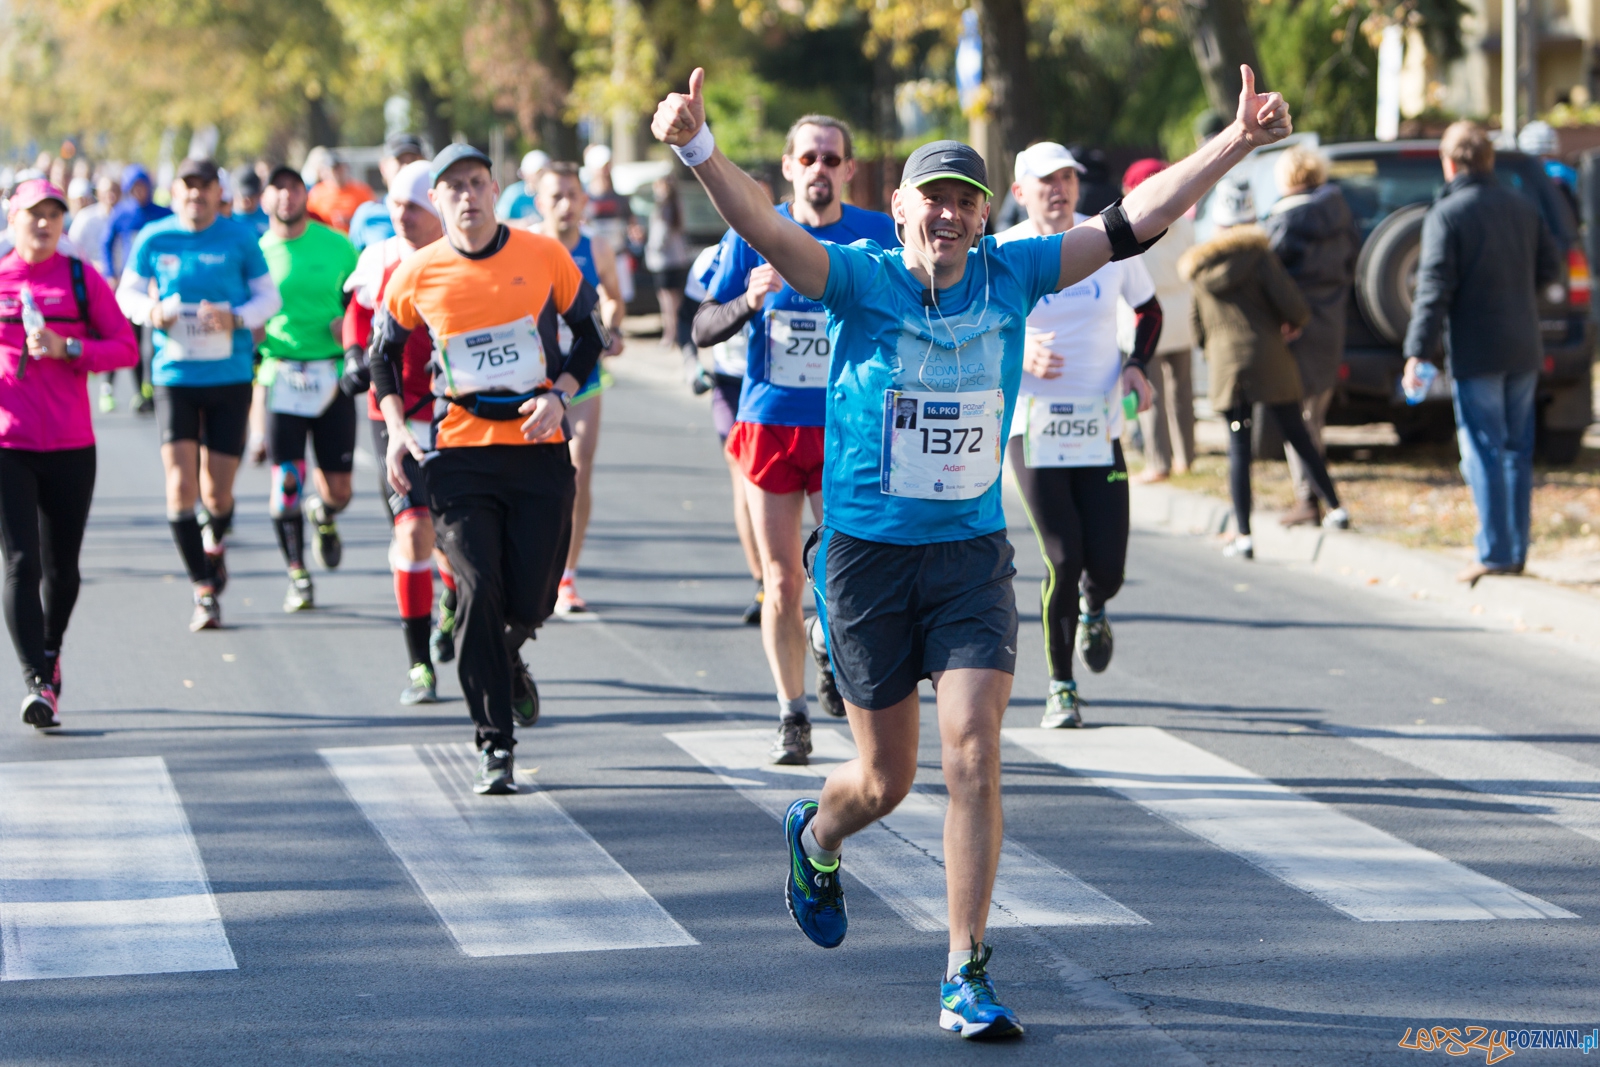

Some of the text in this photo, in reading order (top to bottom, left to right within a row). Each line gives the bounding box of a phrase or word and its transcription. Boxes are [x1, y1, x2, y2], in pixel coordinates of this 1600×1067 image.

[785, 336, 830, 356] 270
[471, 343, 519, 371] 765
[925, 362, 985, 377] ODWAGA
[927, 407, 958, 415] 16. PKO
[1042, 419, 1098, 437] 4056
[919, 427, 983, 455] 1372
[942, 464, 966, 472] Adam
